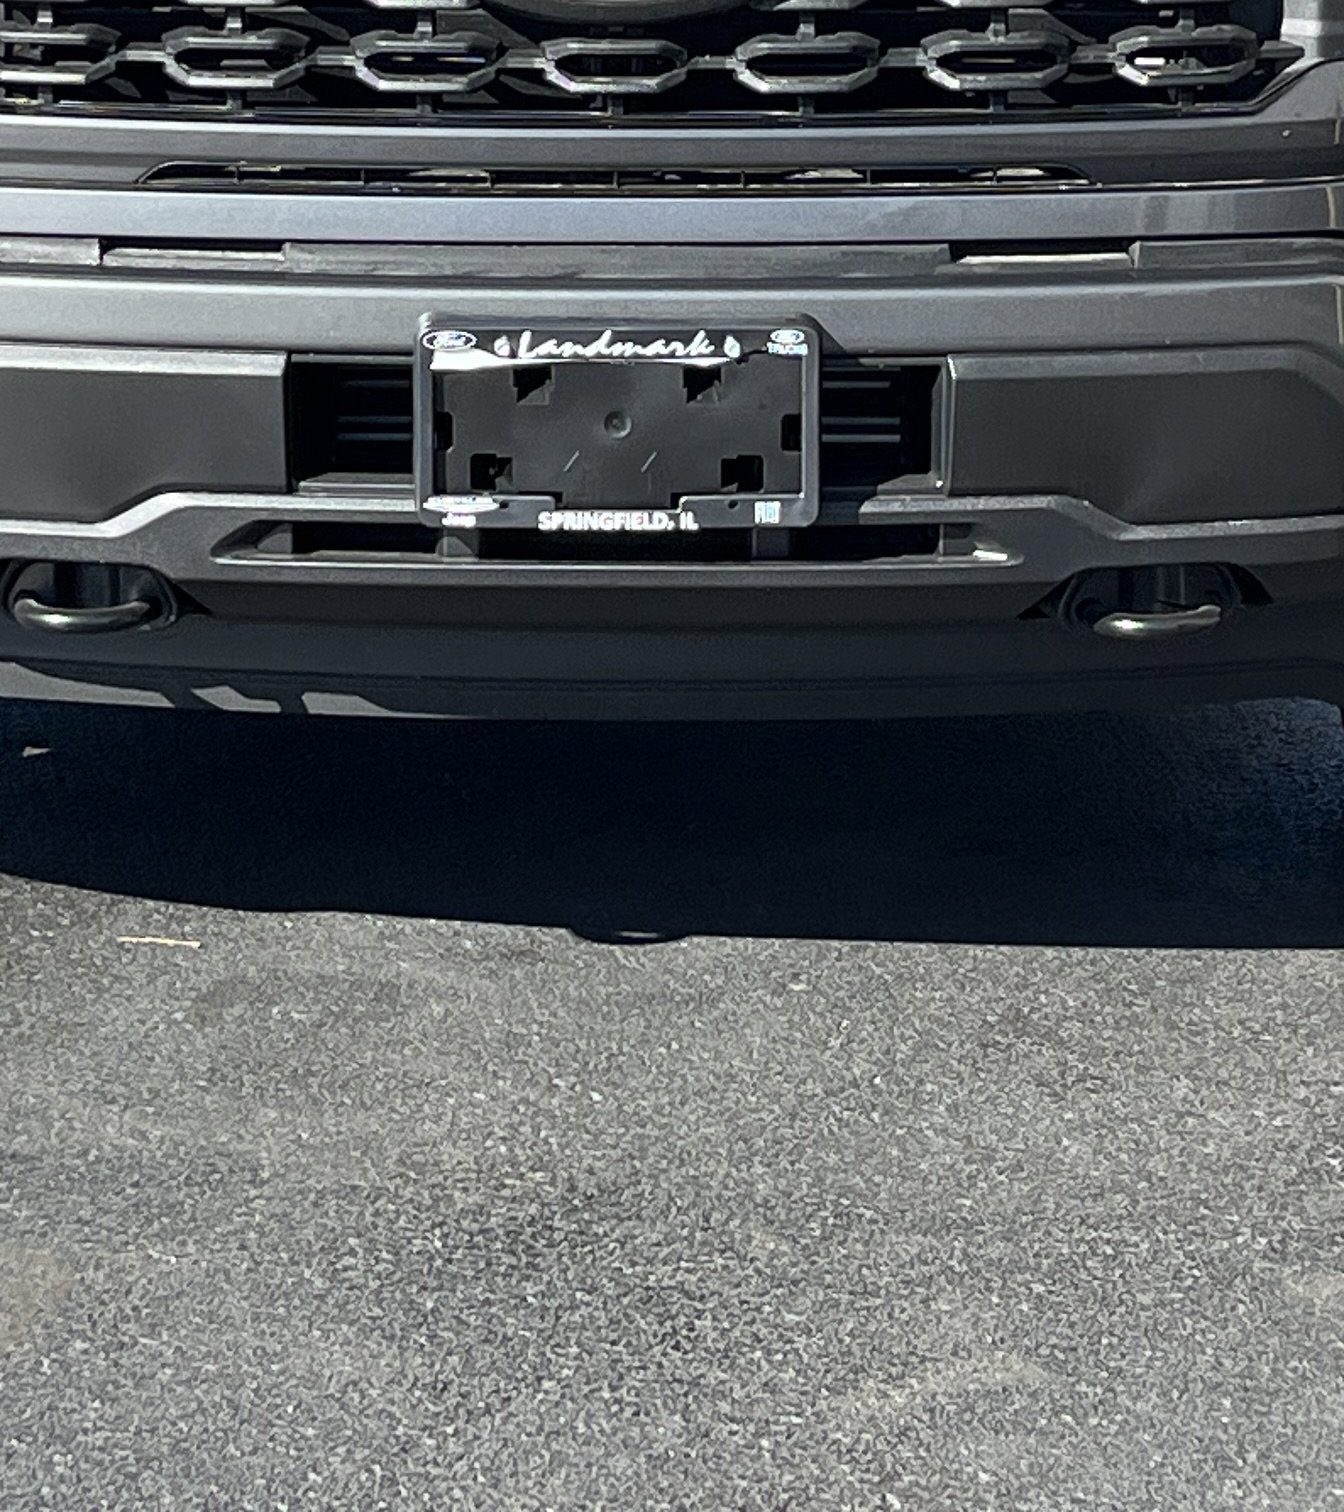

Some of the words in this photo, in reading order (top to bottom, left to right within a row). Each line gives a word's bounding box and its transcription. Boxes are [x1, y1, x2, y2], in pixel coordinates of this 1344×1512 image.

[516, 329, 716, 359] Landmark
[537, 511, 675, 531] SPRINGFIELD,
[679, 512, 699, 531] IL
